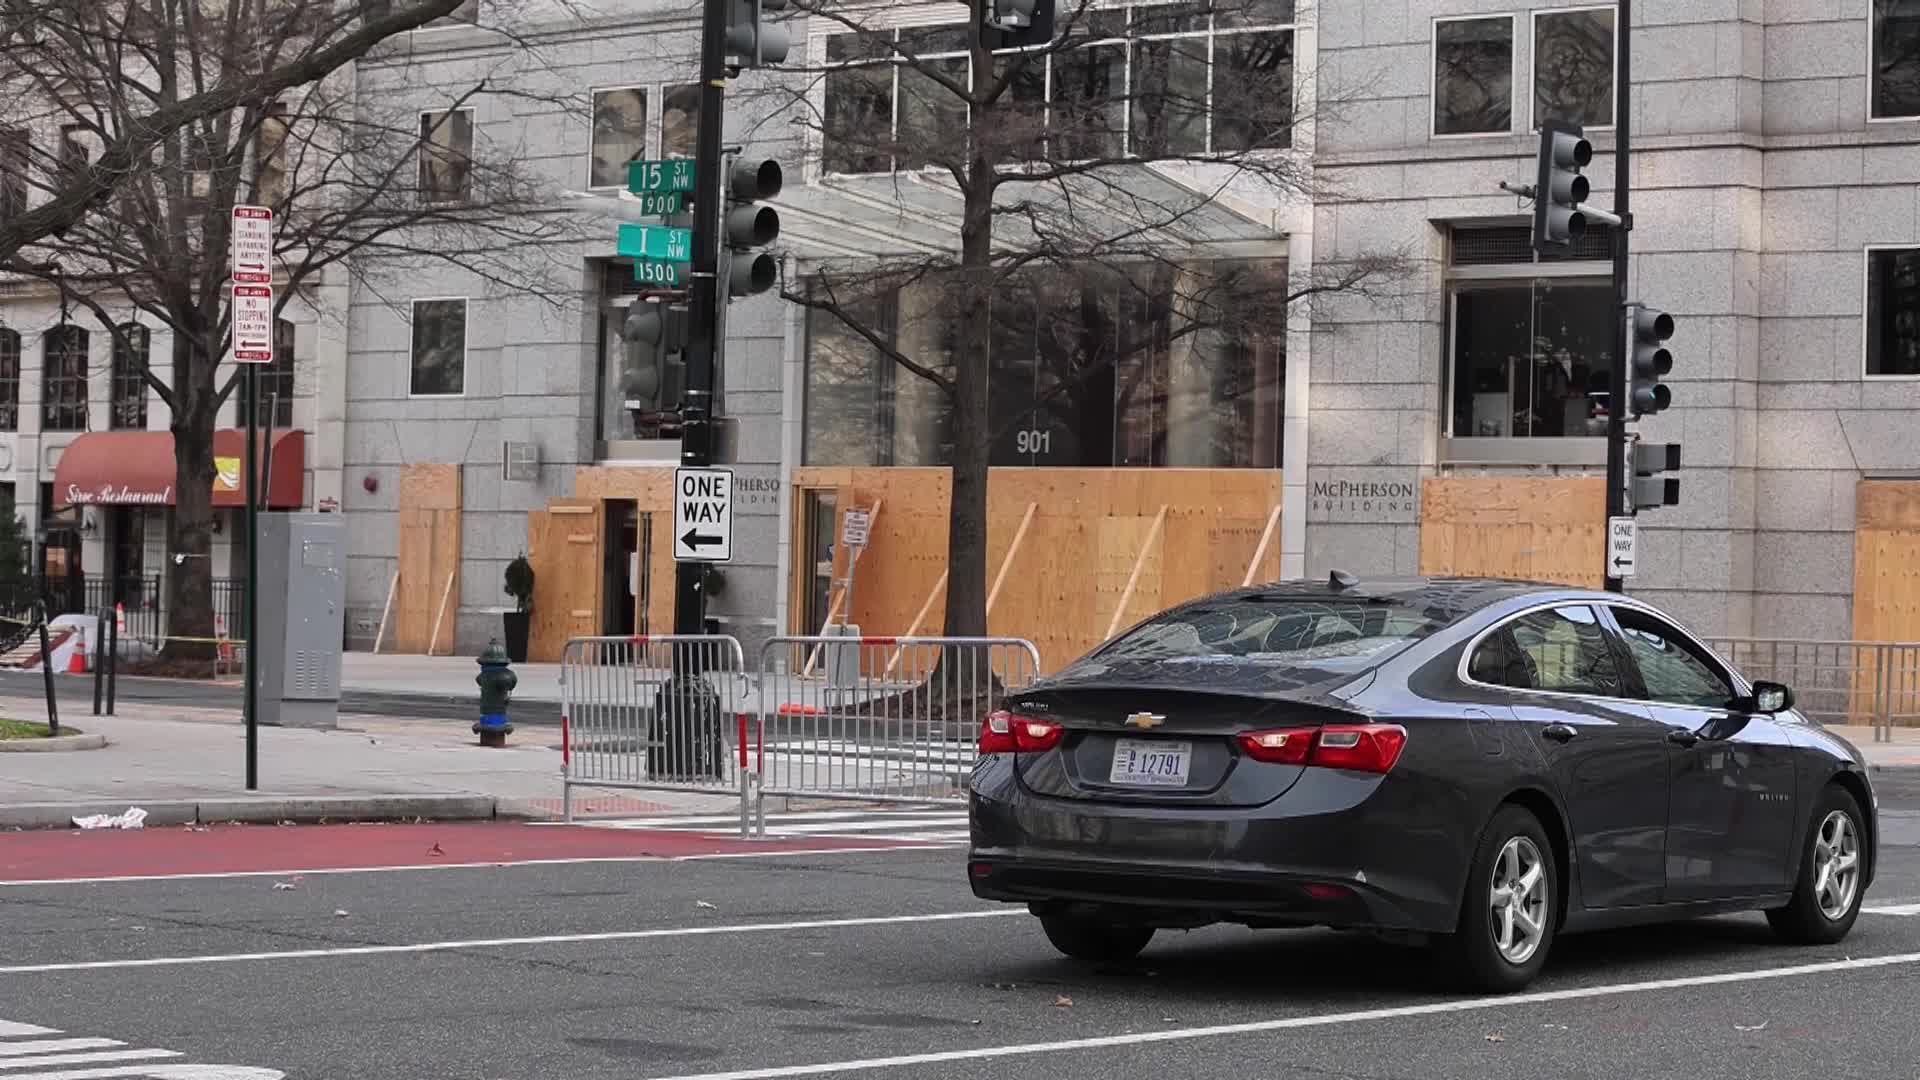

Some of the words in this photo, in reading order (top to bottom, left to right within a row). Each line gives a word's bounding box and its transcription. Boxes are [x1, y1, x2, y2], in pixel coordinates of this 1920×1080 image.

[674, 162, 688, 175] ST
[641, 163, 662, 190] 15
[672, 175, 689, 190] NW
[647, 196, 675, 214] 900
[247, 221, 257, 229] NO
[238, 230, 266, 240] STANDING
[640, 228, 648, 253] I
[669, 230, 682, 244] ST
[243, 241, 268, 251] PARKING
[667, 244, 685, 258] NW
[240, 251, 265, 261] ANYTIME
[639, 262, 674, 281] 1500
[246, 299, 257, 309] NO
[238, 310, 268, 322] STOPPING
[1017, 430, 1050, 454] 901
[97, 484, 171, 504] Restaurant
[682, 476, 725, 498] ONE
[683, 501, 726, 523] WAY
[1312, 500, 1413, 512] BUILDING
[1614, 524, 1632, 537] ONE
[1614, 539, 1632, 552] WAY
[1139, 753, 1181, 776] 12791
